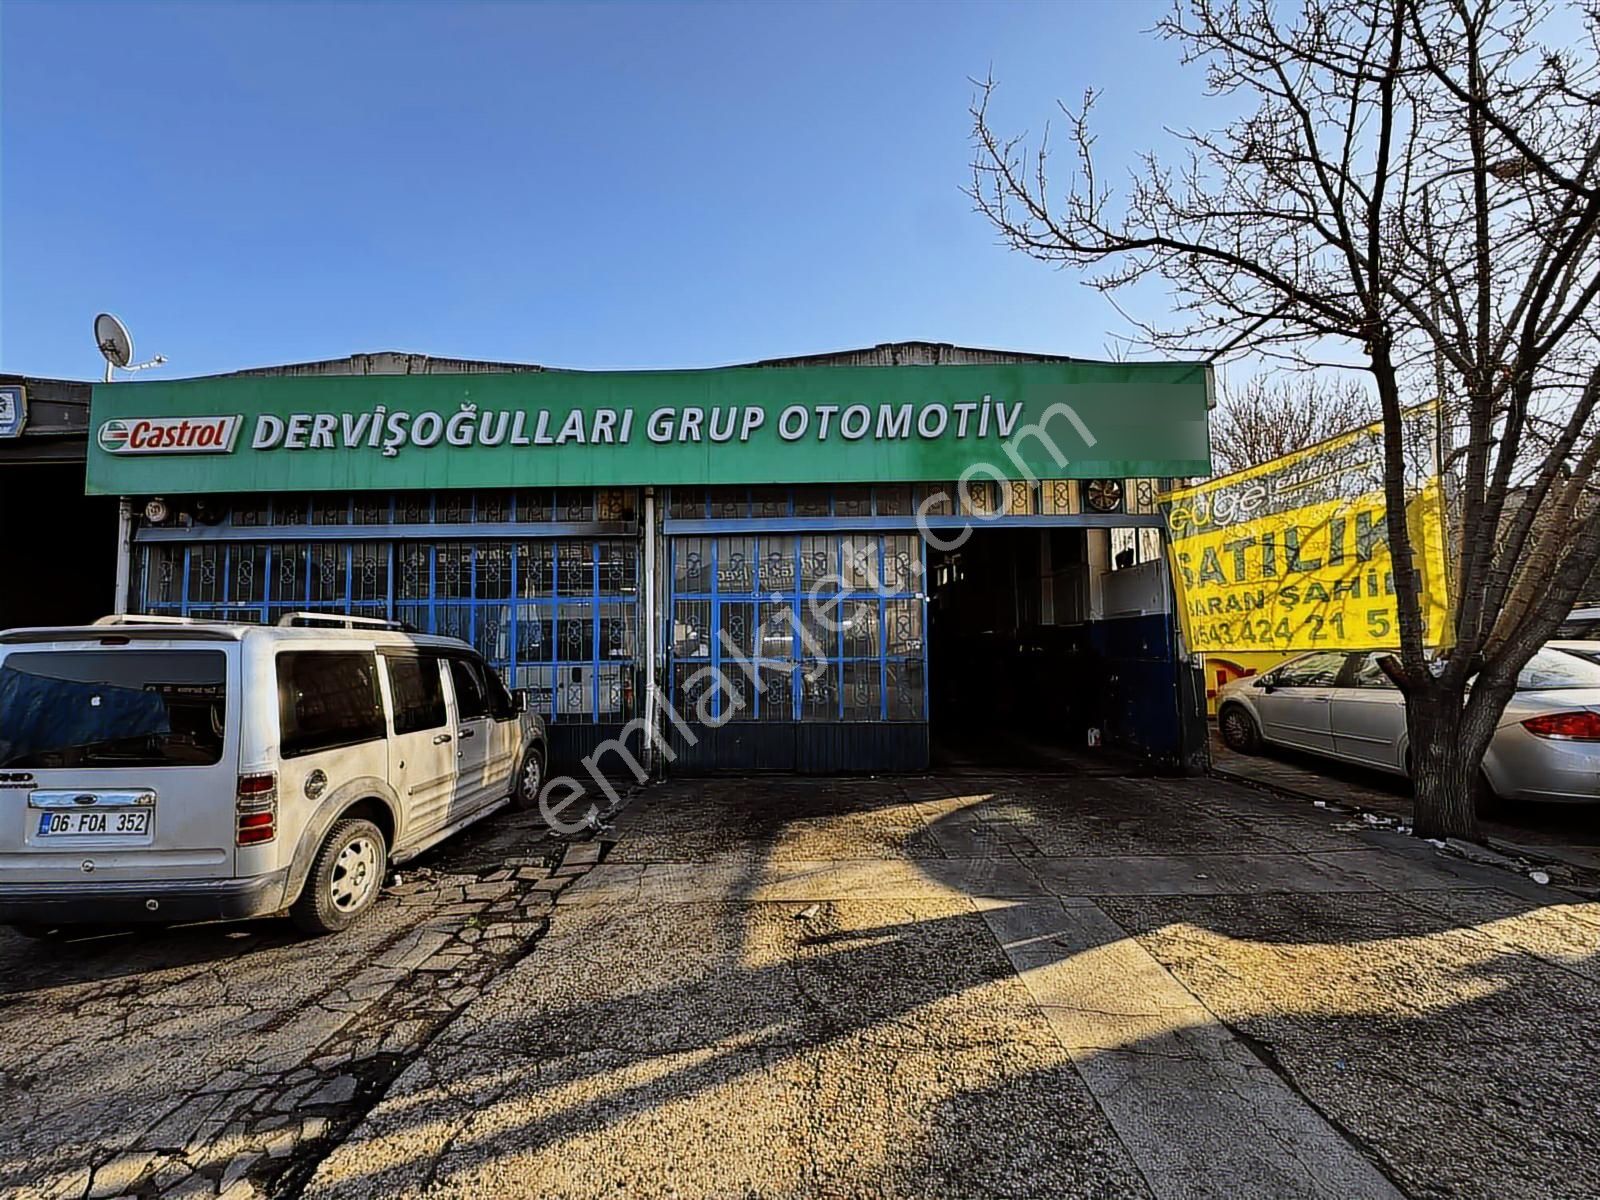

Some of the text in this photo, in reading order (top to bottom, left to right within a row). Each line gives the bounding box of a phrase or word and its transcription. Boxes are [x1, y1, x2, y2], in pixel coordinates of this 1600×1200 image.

[129, 418, 226, 449] Castrol
[250, 394, 1024, 457] DERVİŞOĞULLARI GRUP OTOMOTİV
[1241, 616, 1294, 643] 424
[1305, 611, 1346, 640] 21
[50, 815, 71, 832] 06
[78, 815, 107, 832] FOA
[116, 814, 145, 831] 352
